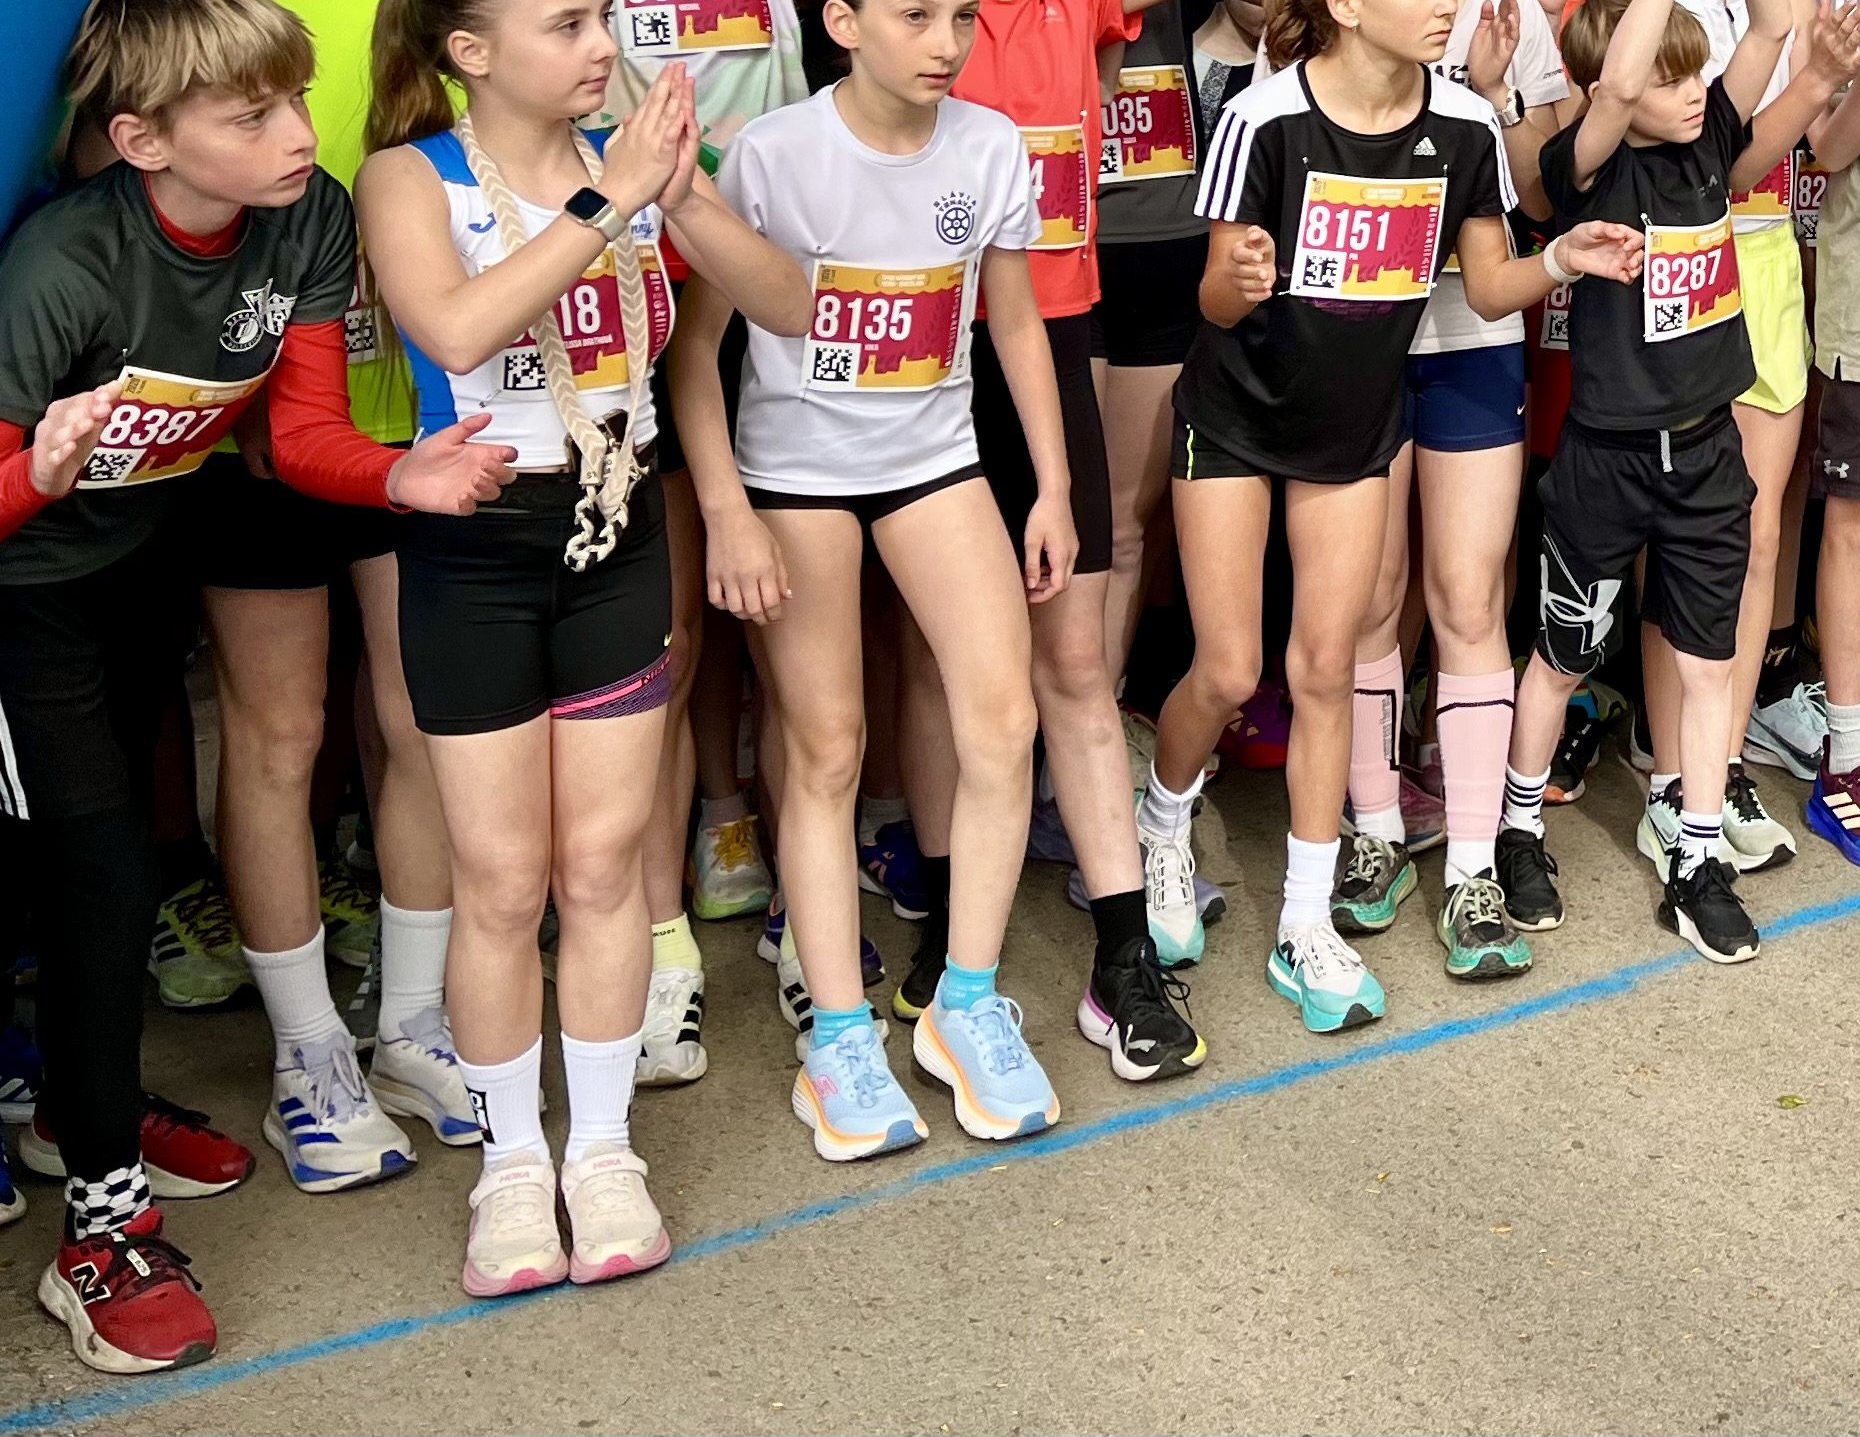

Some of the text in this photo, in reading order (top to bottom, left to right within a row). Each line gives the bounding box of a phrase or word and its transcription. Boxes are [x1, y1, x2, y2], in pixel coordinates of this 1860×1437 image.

[1305, 205, 1391, 252] 8151
[1650, 248, 1722, 297] 8287
[814, 295, 914, 342] 8135
[100, 403, 225, 446] 8387
